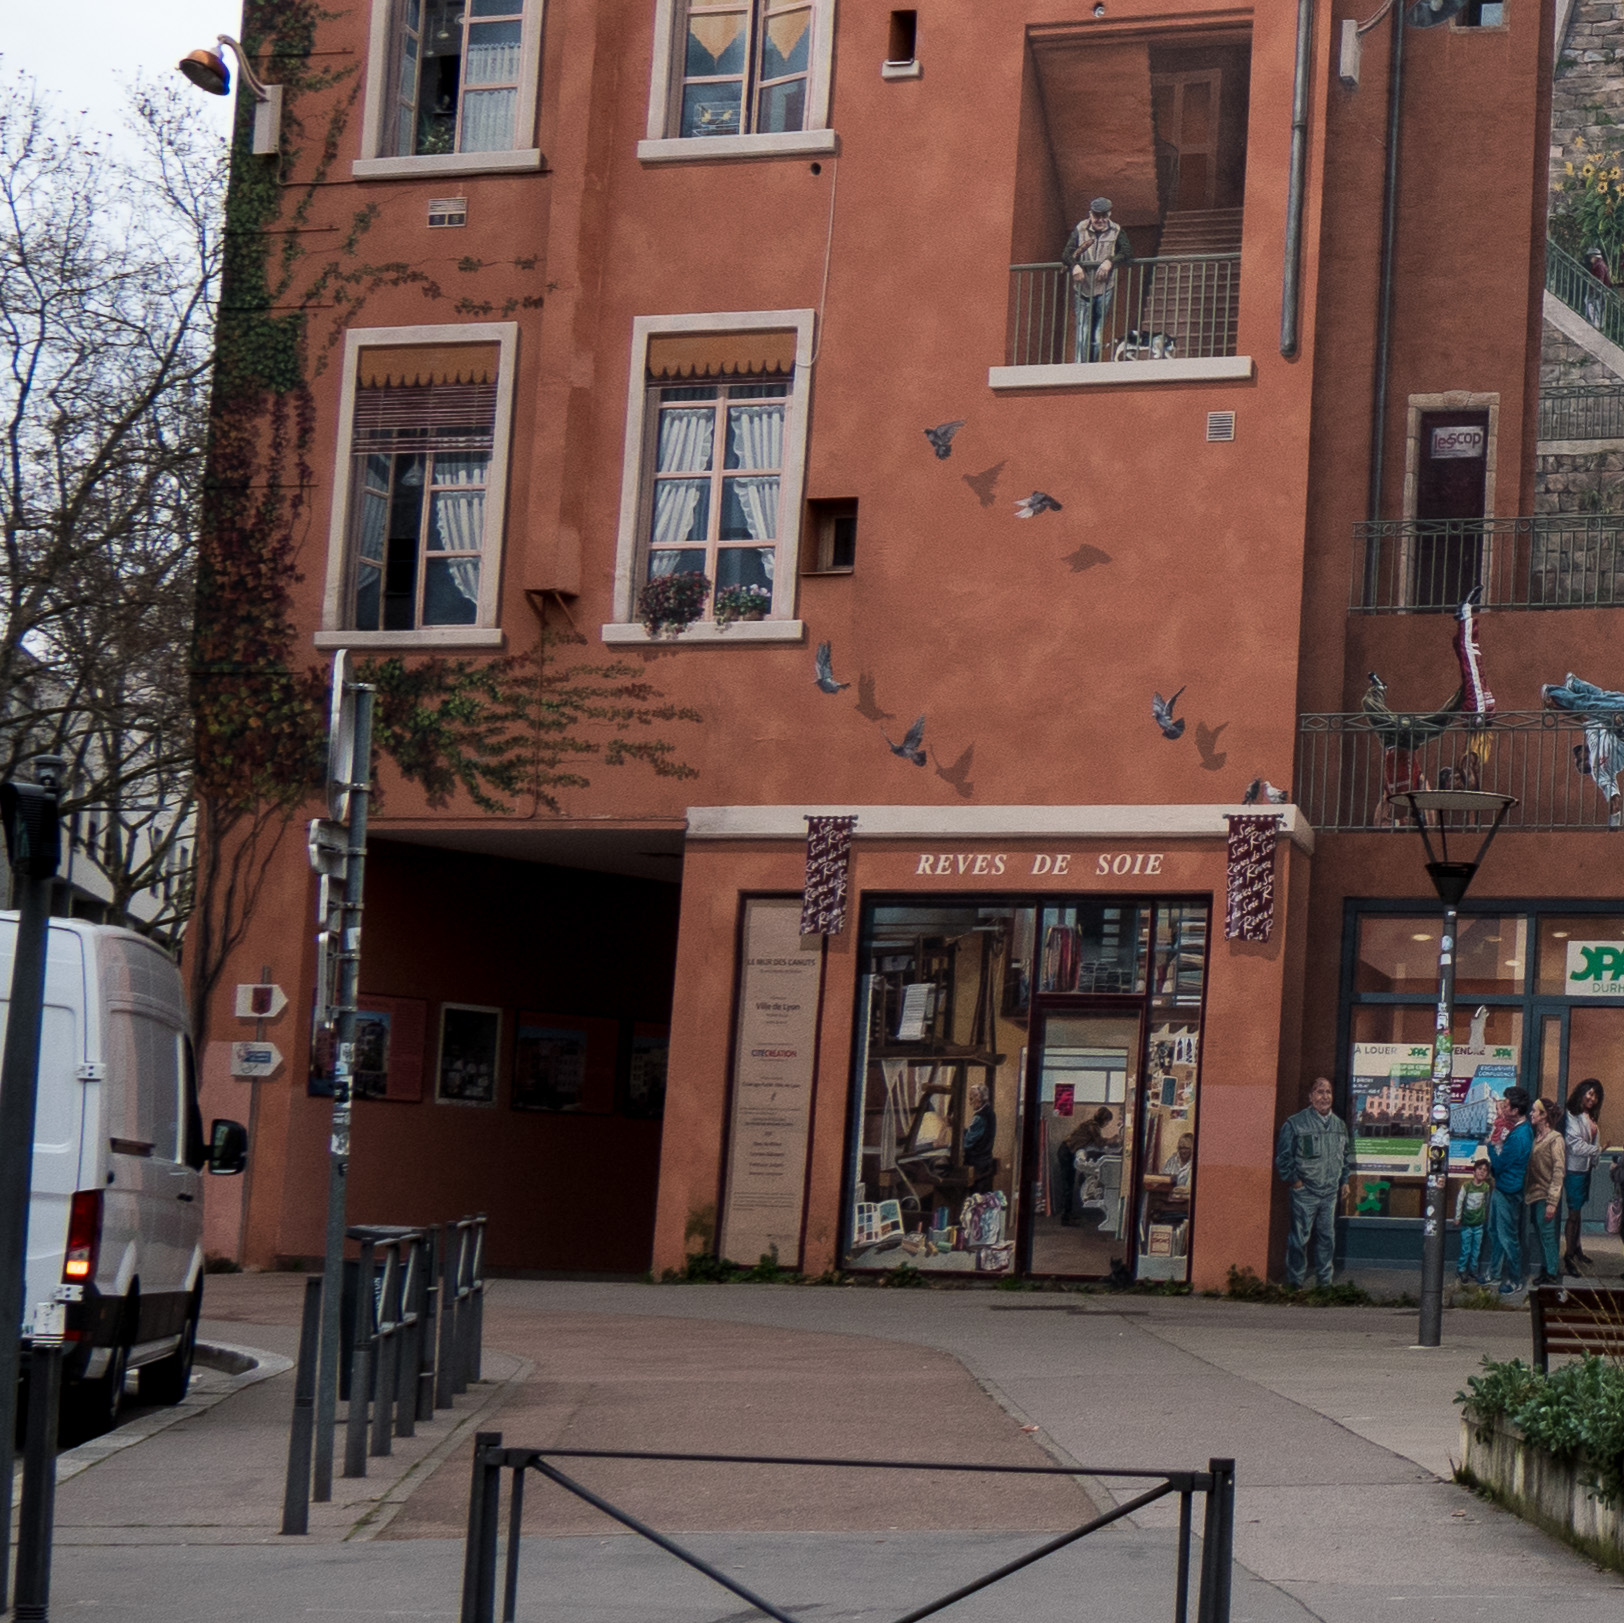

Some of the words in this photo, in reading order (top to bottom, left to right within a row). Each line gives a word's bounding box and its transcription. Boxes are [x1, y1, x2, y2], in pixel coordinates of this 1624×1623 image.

[914, 853, 1008, 876] REVES
[1030, 853, 1071, 876] DE
[1095, 853, 1165, 876] SOIE
[1364, 1046, 1398, 1055] LOUER
